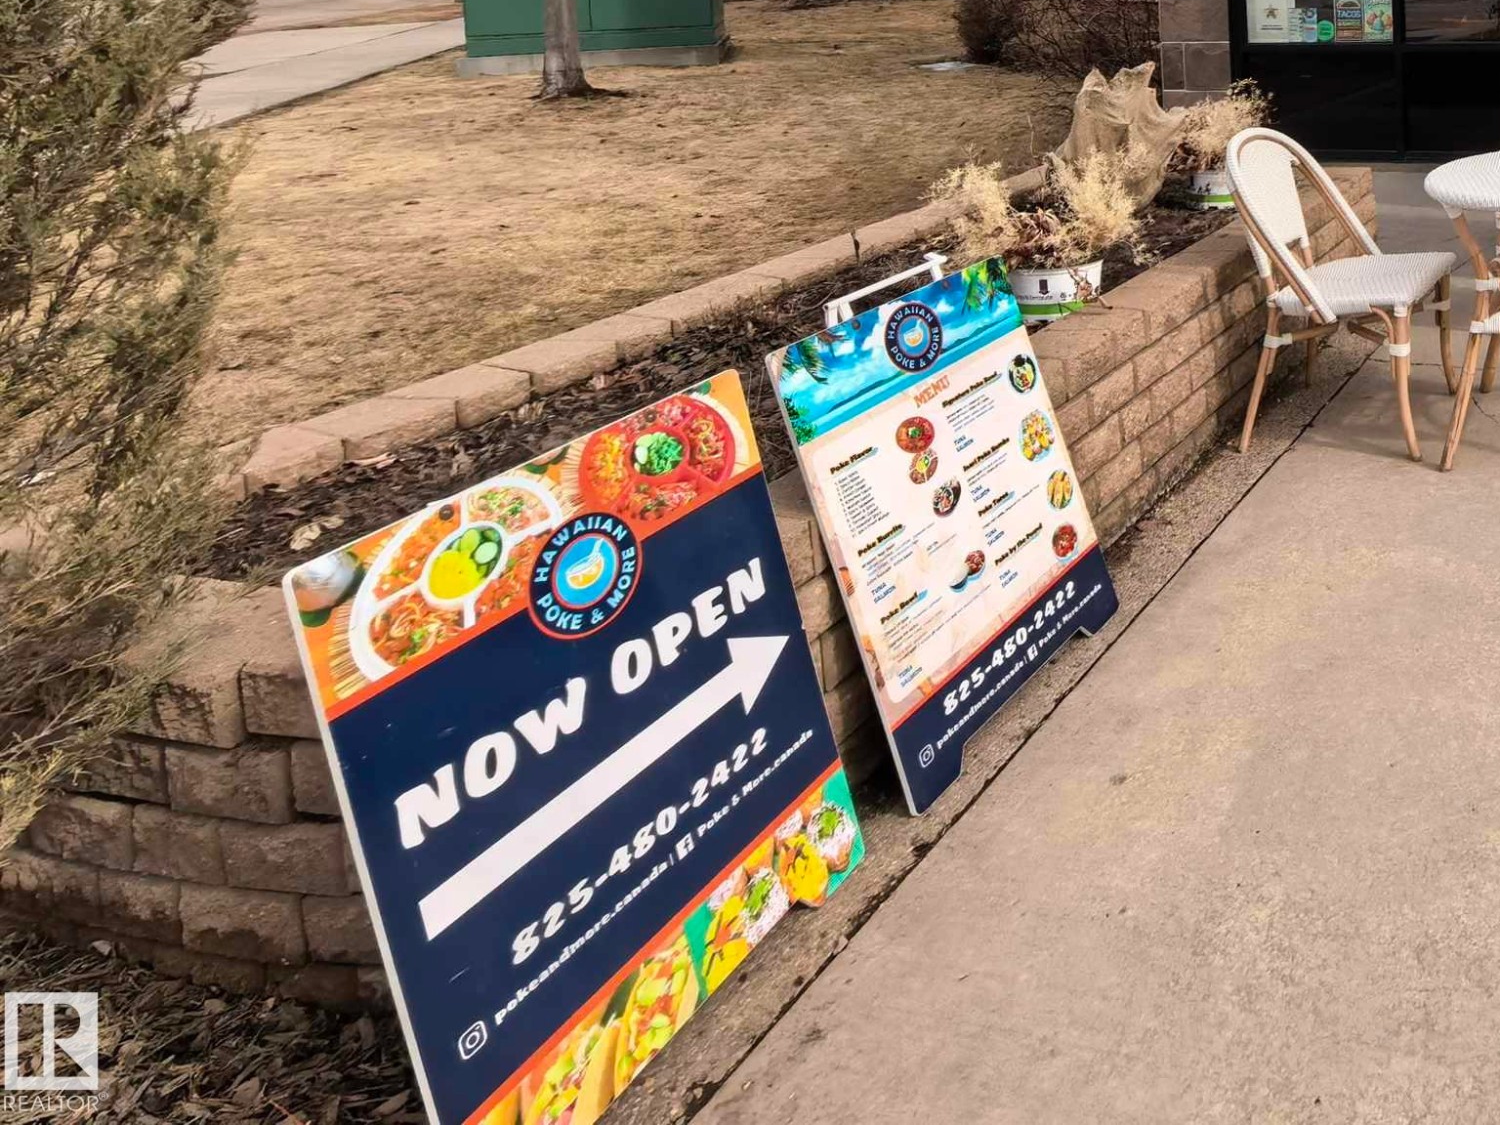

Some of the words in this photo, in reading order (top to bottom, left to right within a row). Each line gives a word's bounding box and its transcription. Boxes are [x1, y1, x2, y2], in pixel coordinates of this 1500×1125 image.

[887, 306, 934, 340] HAWAIIAN
[890, 345, 915, 370] POKE
[919, 359, 926, 368] &
[927, 326, 940, 361] MORE
[913, 374, 950, 408] MENU
[970, 380, 983, 391] Poke
[829, 459, 849, 474] Poke
[849, 446, 873, 463] Flavor
[977, 449, 991, 461] Poke
[977, 503, 992, 517] Poke
[534, 516, 628, 583] HAWAIIAN
[857, 540, 876, 557] Poke
[994, 551, 1009, 566] Poke
[1008, 544, 1016, 555] by
[1016, 537, 1026, 547] the
[1025, 522, 1042, 539] Pound
[536, 592, 583, 631] POKE
[591, 608, 604, 625] &
[606, 546, 636, 609] MORE
[871, 581, 886, 595] TUNA
[873, 584, 896, 604] SALMON
[880, 607, 899, 624] Poke
[899, 591, 918, 609] Bowl
[943, 580, 1076, 716] 825-480-2422
[936, 660, 1025, 750] pokeandmore.canada
[1038, 629, 1057, 649] Poke
[1062, 583, 1102, 625] More.canada
[394, 676, 588, 851] NOW
[610, 557, 766, 696] OPEN
[511, 727, 767, 966] 825-480-2422
[494, 862, 669, 1026] pokeandmore.canada
[697, 804, 730, 838] Poke
[731, 792, 740, 807] &
[741, 728, 814, 797] More.canada
